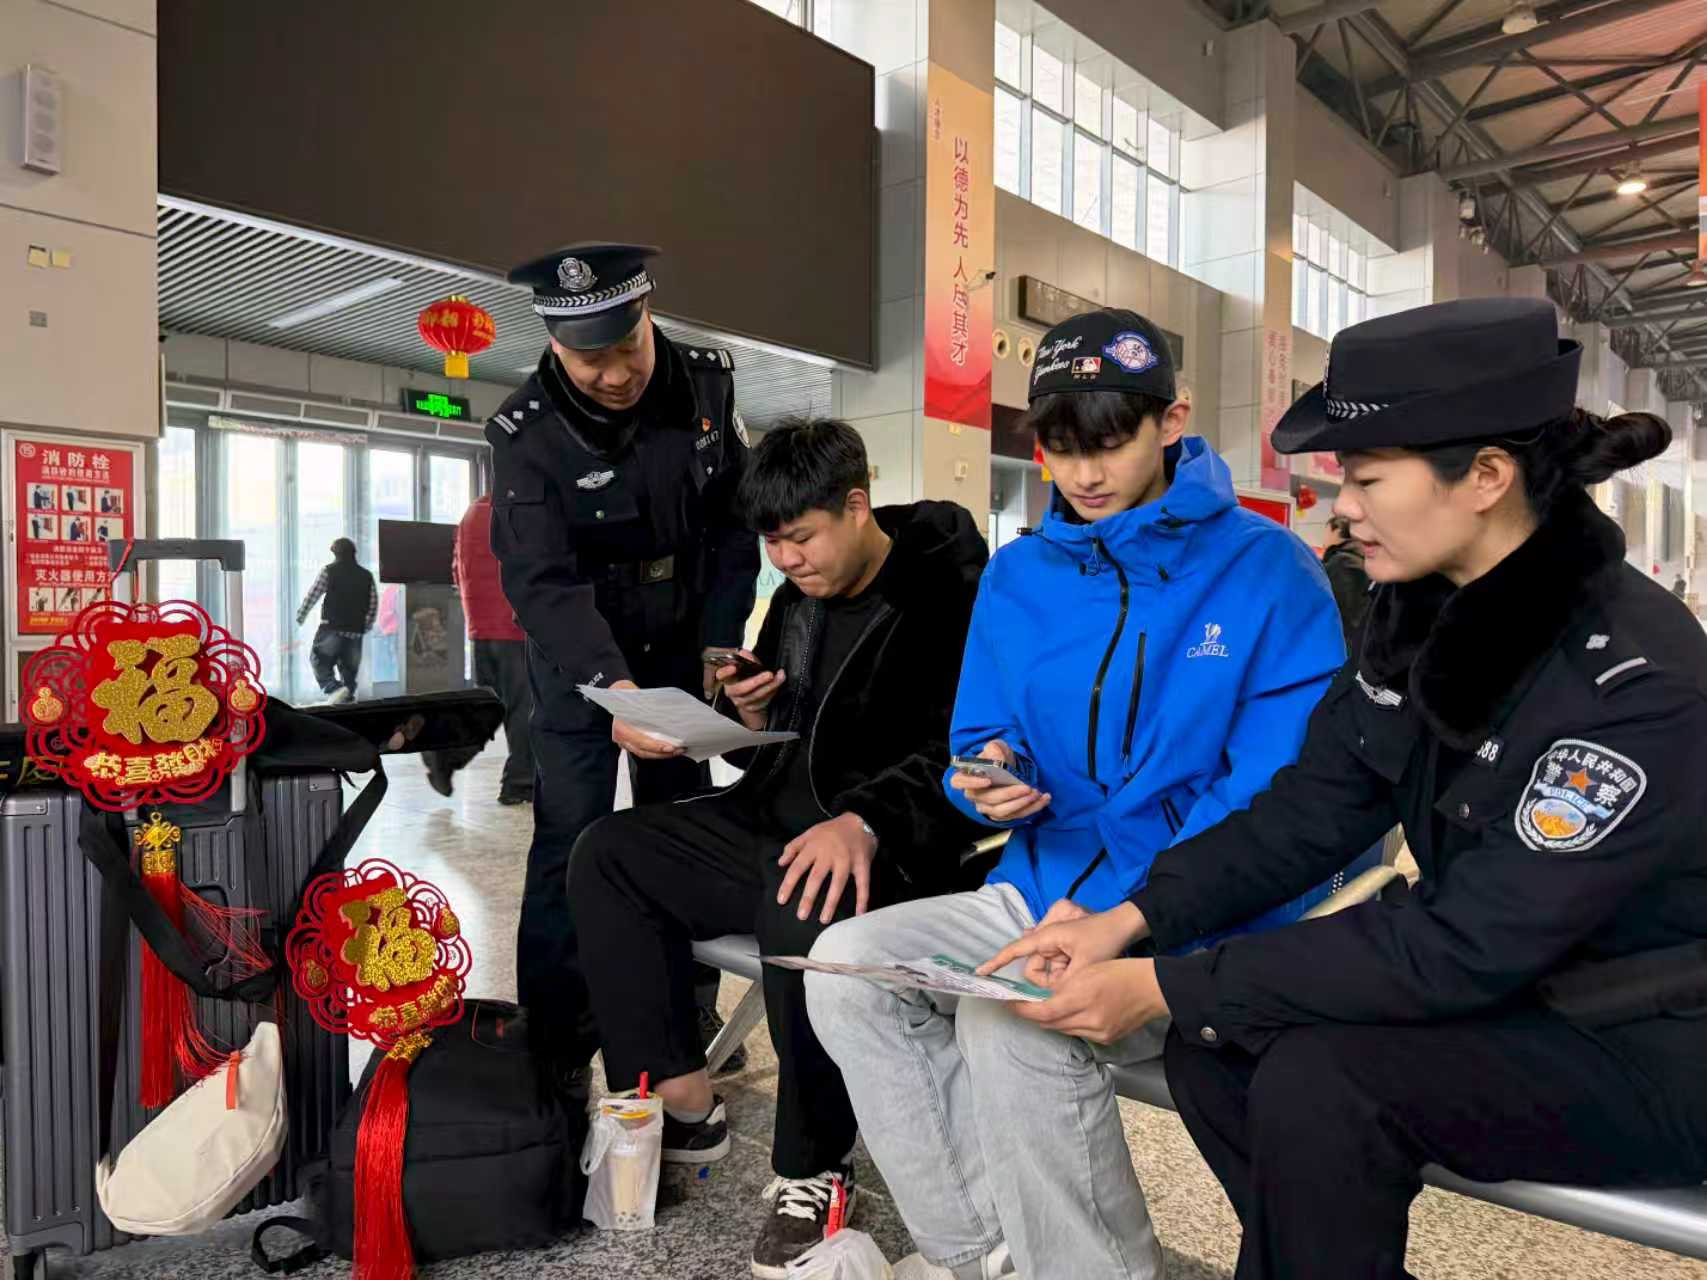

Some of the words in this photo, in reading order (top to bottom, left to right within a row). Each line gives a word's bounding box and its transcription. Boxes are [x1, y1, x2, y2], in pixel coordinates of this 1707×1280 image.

[952, 136, 969, 249] 以德为先
[952, 256, 969, 365] 人尽其才
[1053, 336, 1082, 359] York
[42, 449, 110, 470] 消防栓
[1186, 642, 1229, 658] CAMEL
[91, 634, 219, 744] 福
[1548, 748, 1638, 793] 中华人民共和国
[339, 888, 437, 992] 福
